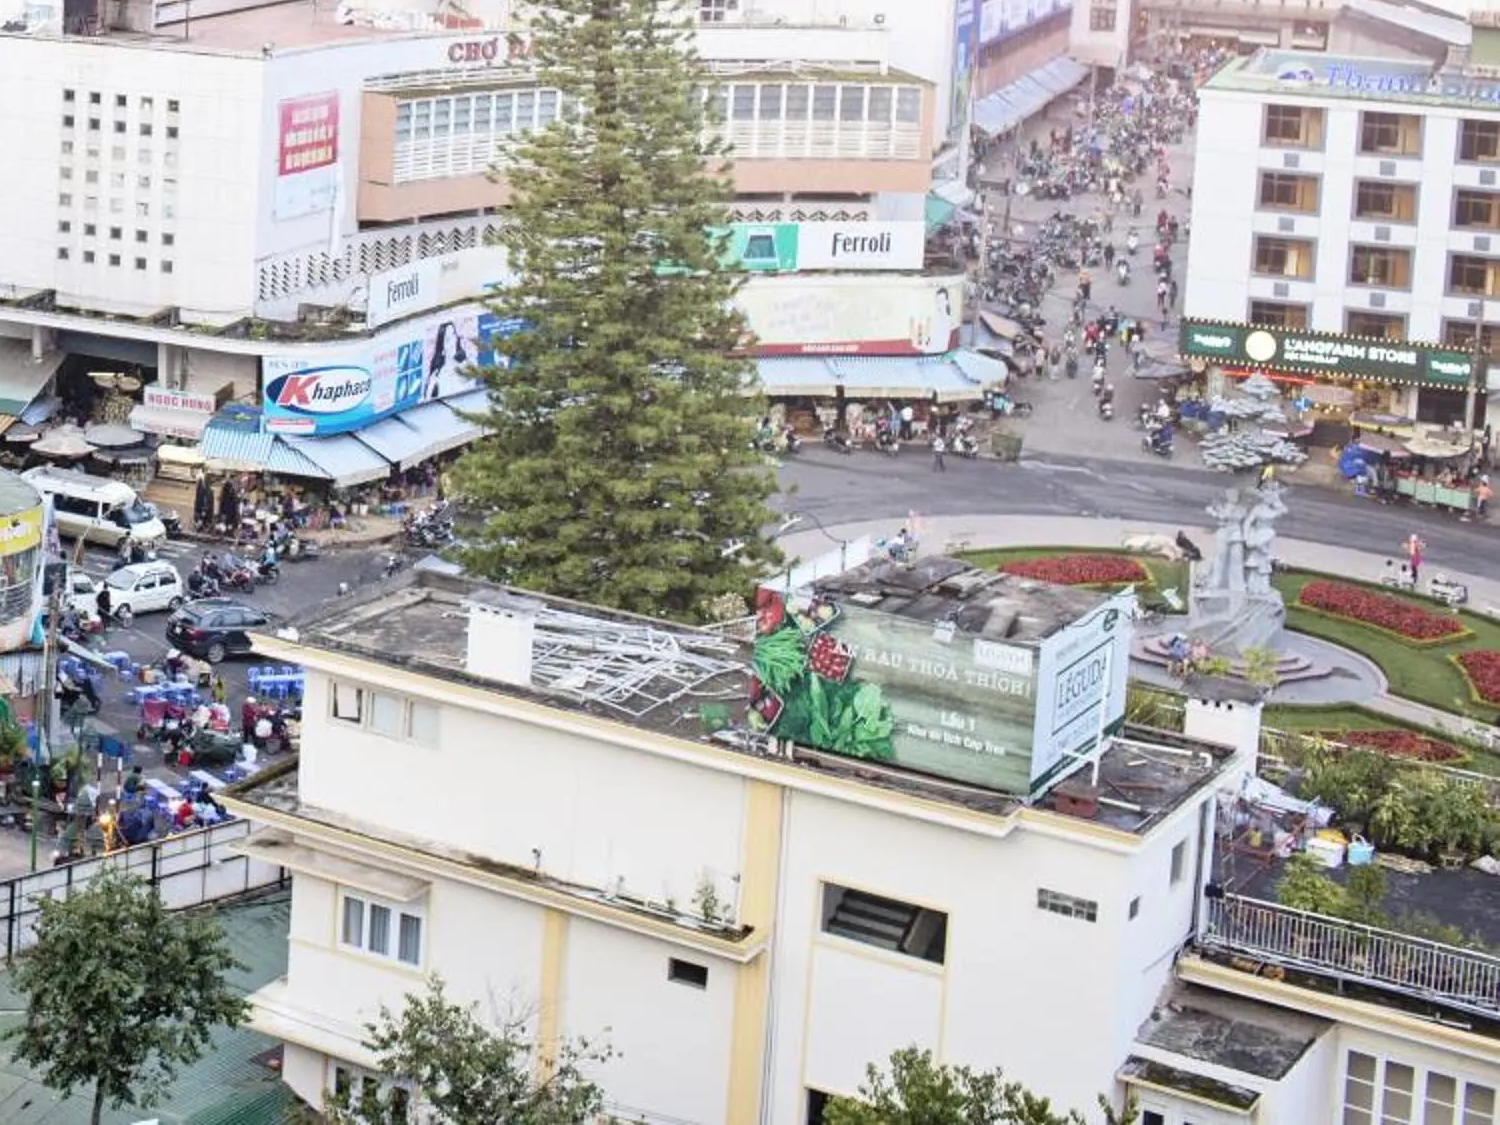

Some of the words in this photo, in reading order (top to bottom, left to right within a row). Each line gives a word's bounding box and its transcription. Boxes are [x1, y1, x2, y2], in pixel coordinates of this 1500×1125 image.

[832, 232, 891, 256] Ferroli
[387, 272, 419, 307] Ferroli
[1367, 347, 1418, 365] STORE
